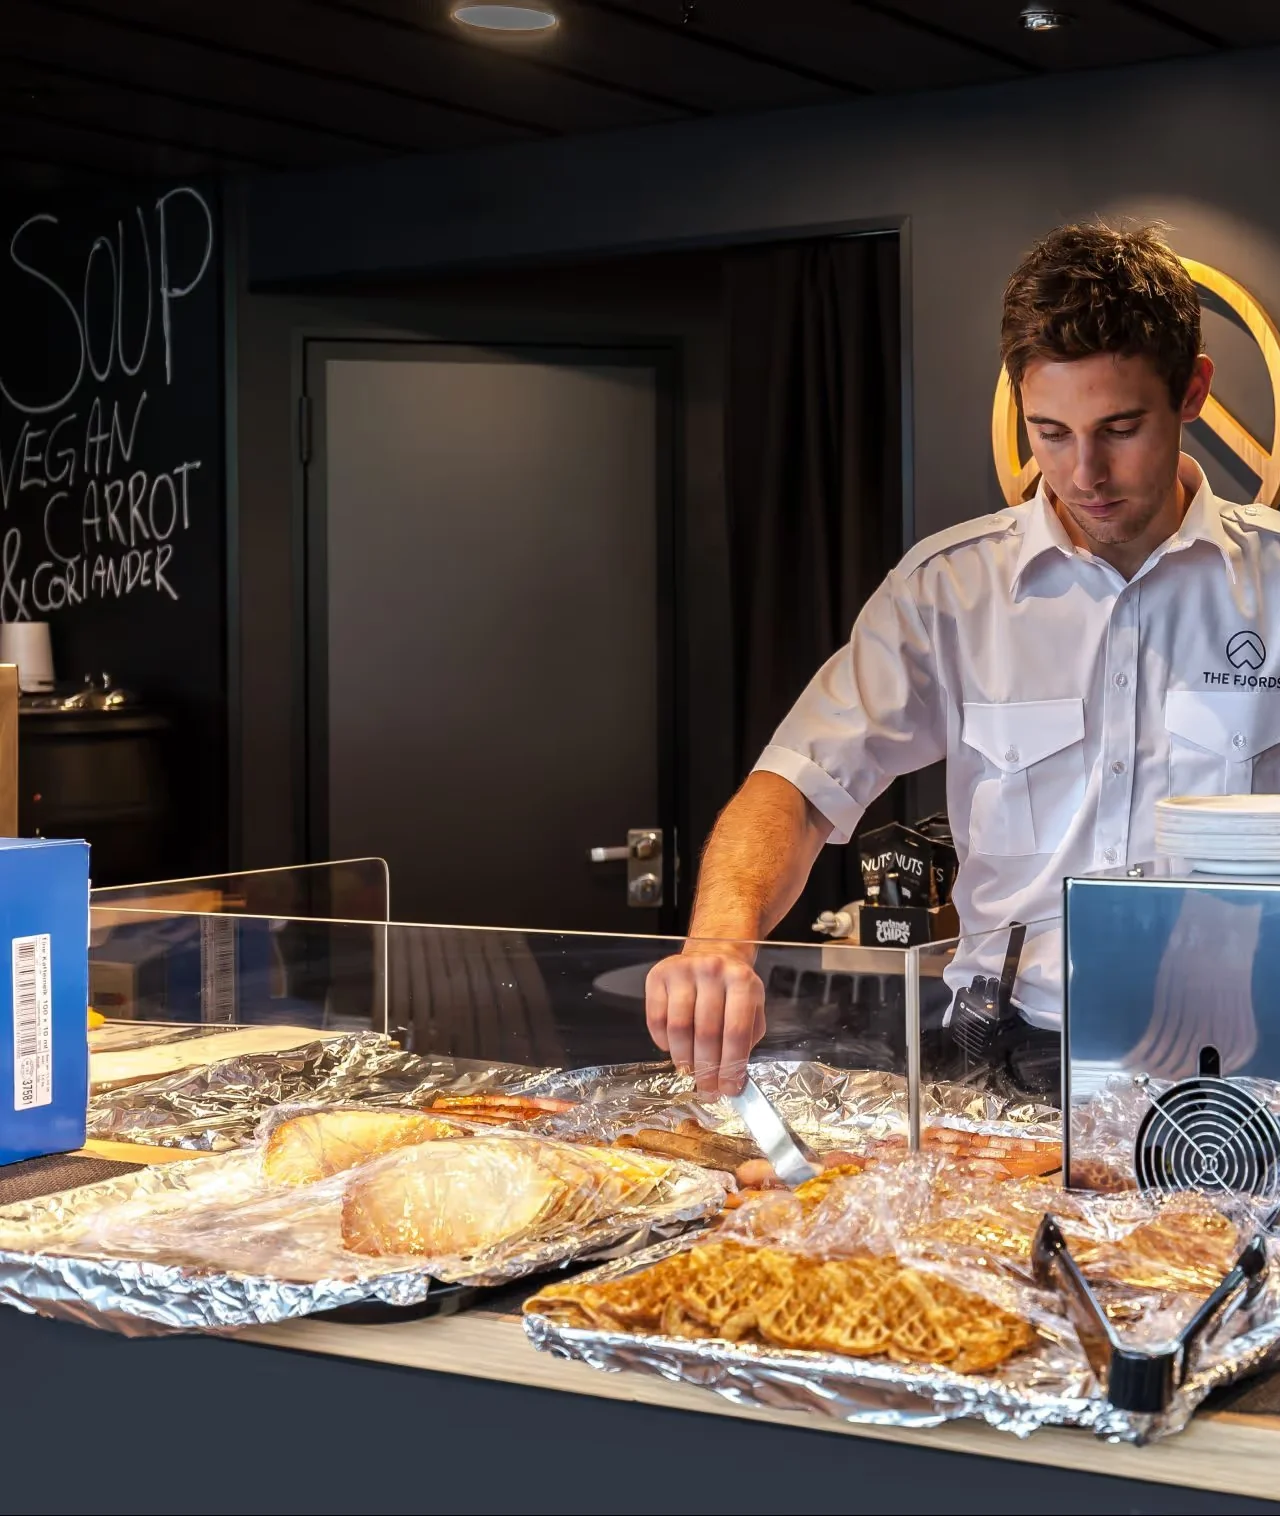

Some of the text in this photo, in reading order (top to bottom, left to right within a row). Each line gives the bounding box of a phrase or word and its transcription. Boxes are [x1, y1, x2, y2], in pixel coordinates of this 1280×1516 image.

[0, 187, 213, 413] SOUP
[44, 461, 201, 562] CARROT
[32, 544, 179, 611] CORIANDER
[1203, 671, 1230, 685] THE
[861, 851, 892, 873] NUTS
[894, 851, 924, 876] NUTS
[877, 927, 910, 943] CHIPS
[21, 1078, 33, 1107] 37581
